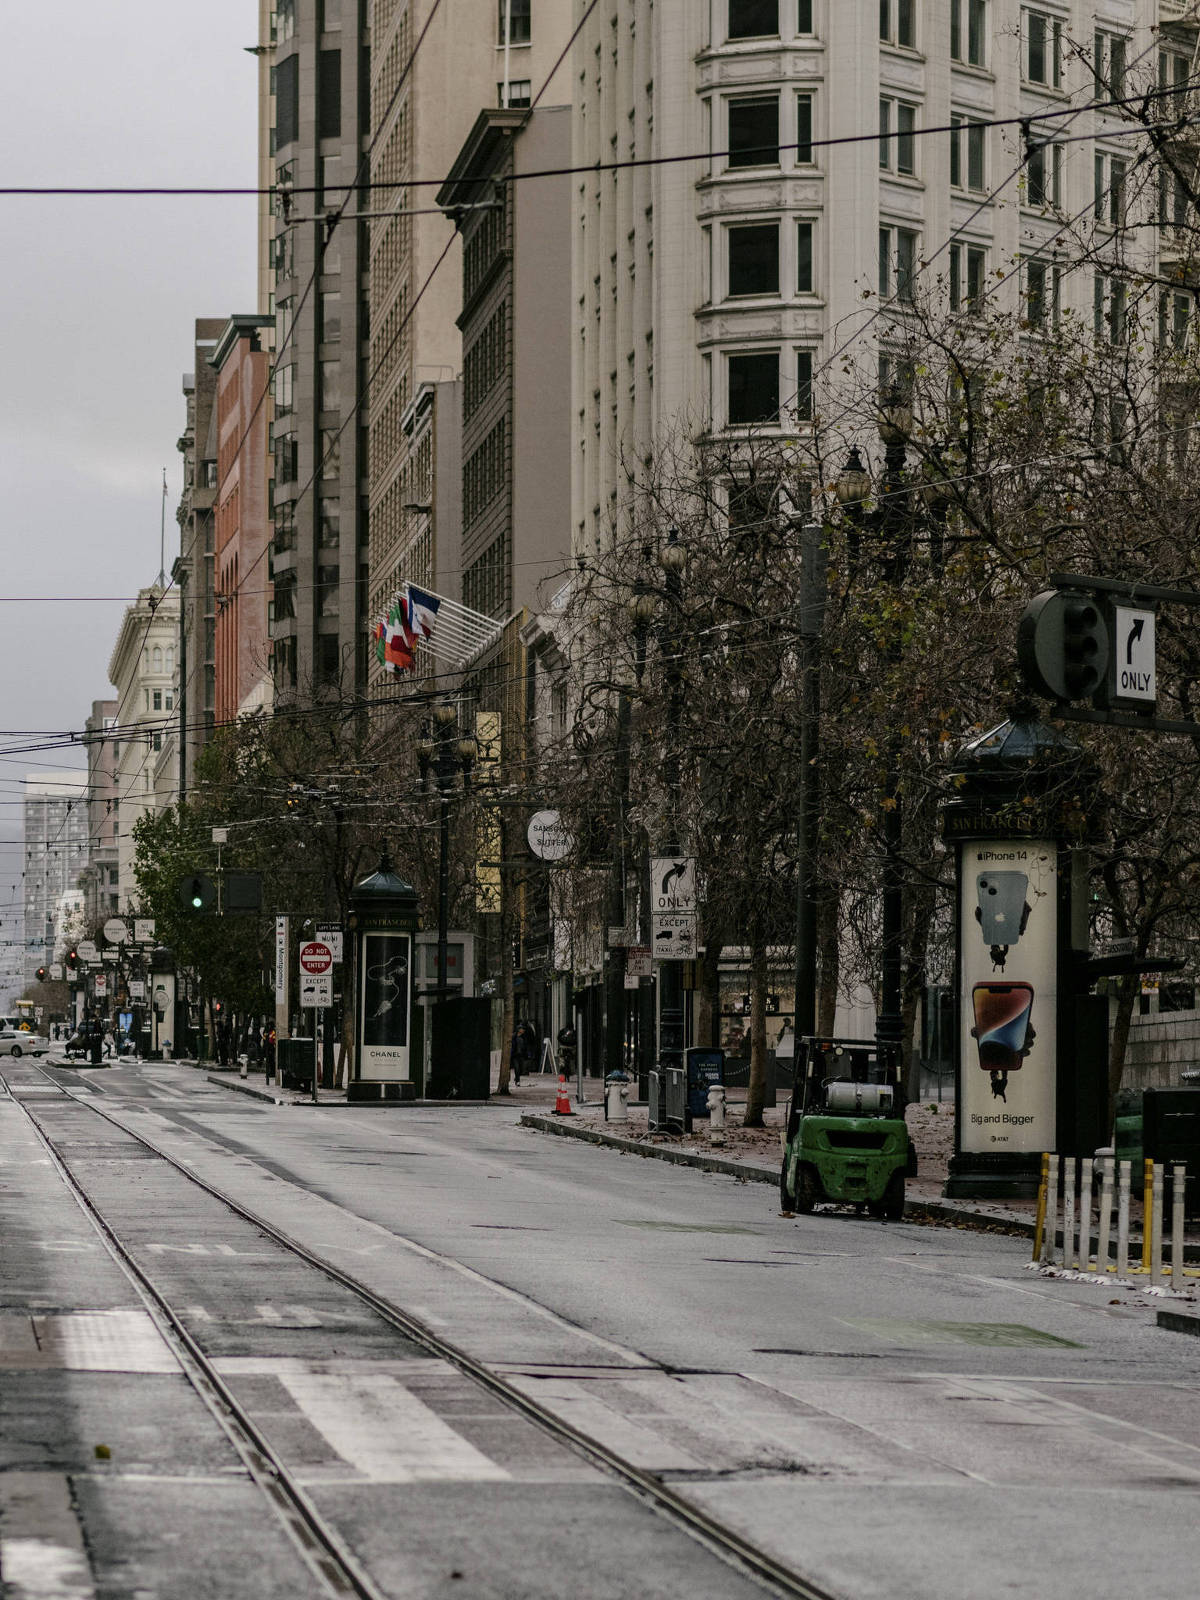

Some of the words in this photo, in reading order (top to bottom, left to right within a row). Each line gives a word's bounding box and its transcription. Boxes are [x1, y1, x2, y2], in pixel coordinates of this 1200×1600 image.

[1121, 671, 1151, 691] ONLY
[984, 852, 1015, 861] iPhone
[1017, 852, 1027, 861] 14
[658, 898, 690, 907] ONLY
[971, 1114, 982, 1125] Big
[984, 1114, 1000, 1123] and
[1002, 1114, 1034, 1125] Bigger
